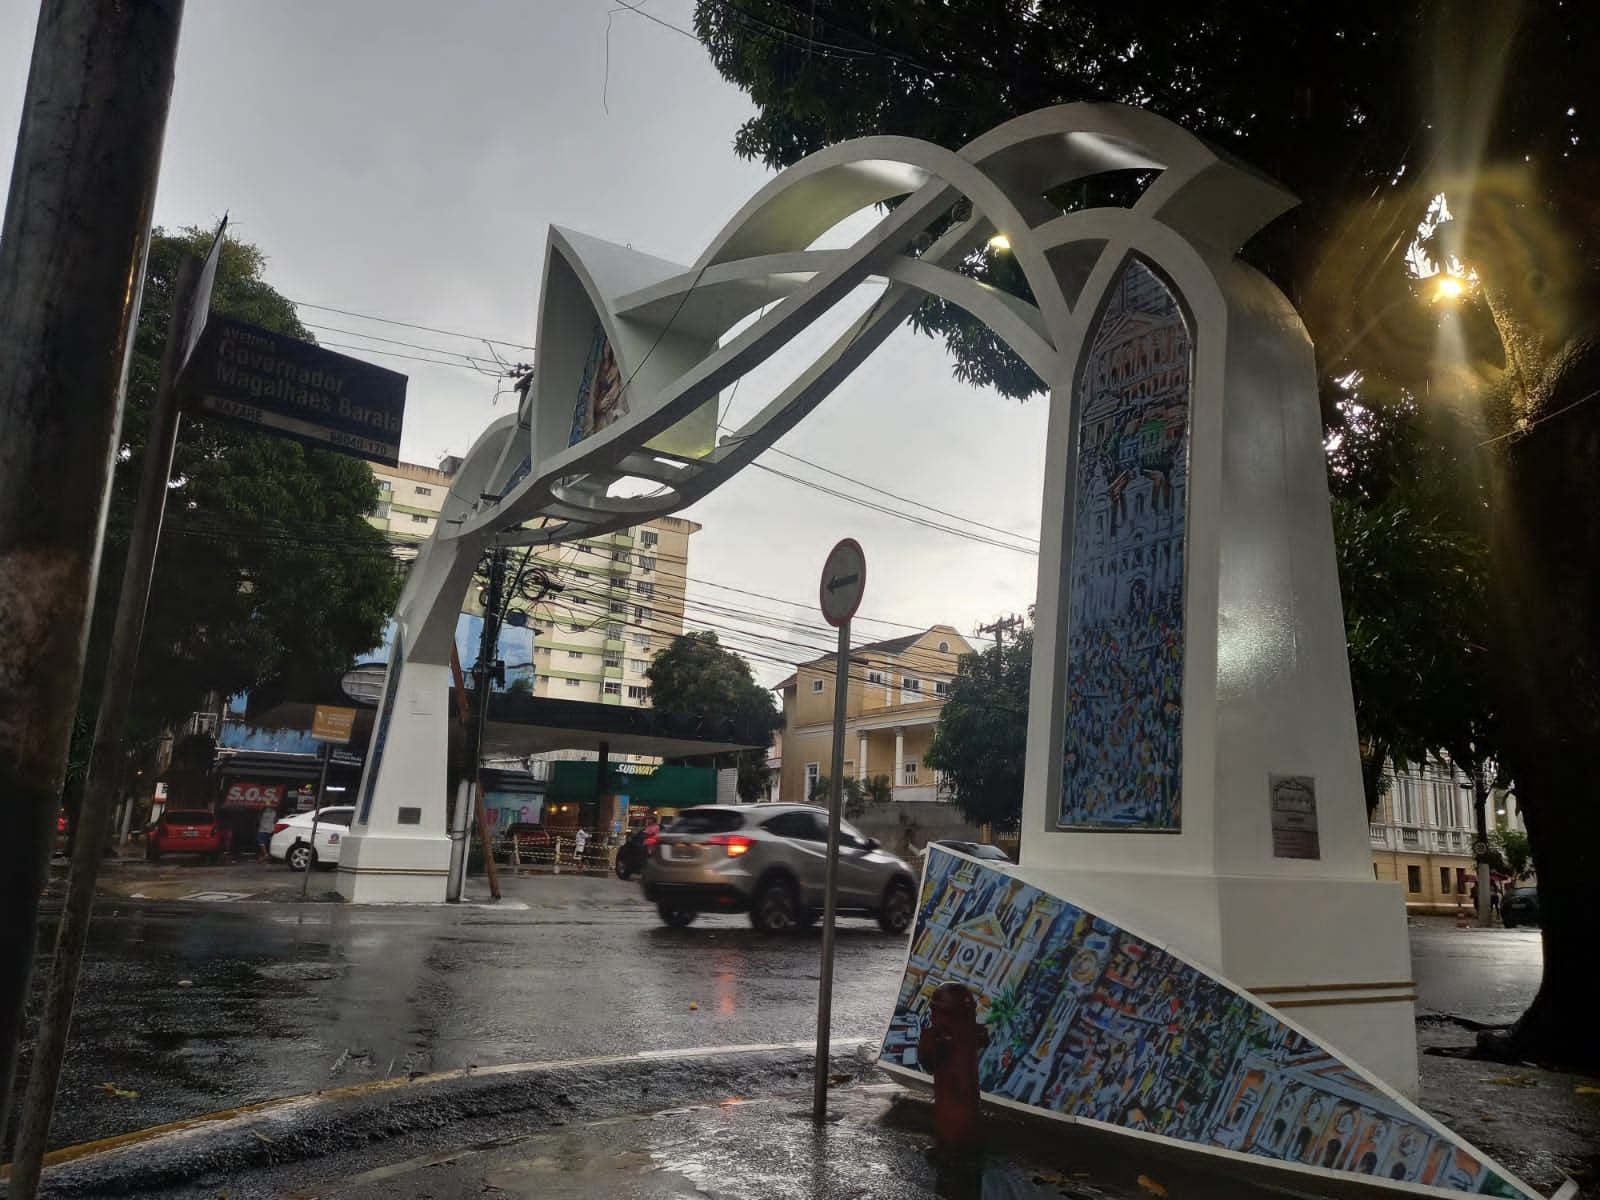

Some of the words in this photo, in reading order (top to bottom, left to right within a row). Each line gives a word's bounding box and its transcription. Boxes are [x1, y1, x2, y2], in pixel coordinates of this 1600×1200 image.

[219, 340, 344, 394] Governador
[216, 361, 331, 412] Magalhães
[616, 763, 658, 775] SUBWAY
[228, 786, 280, 802] S.O.S.
